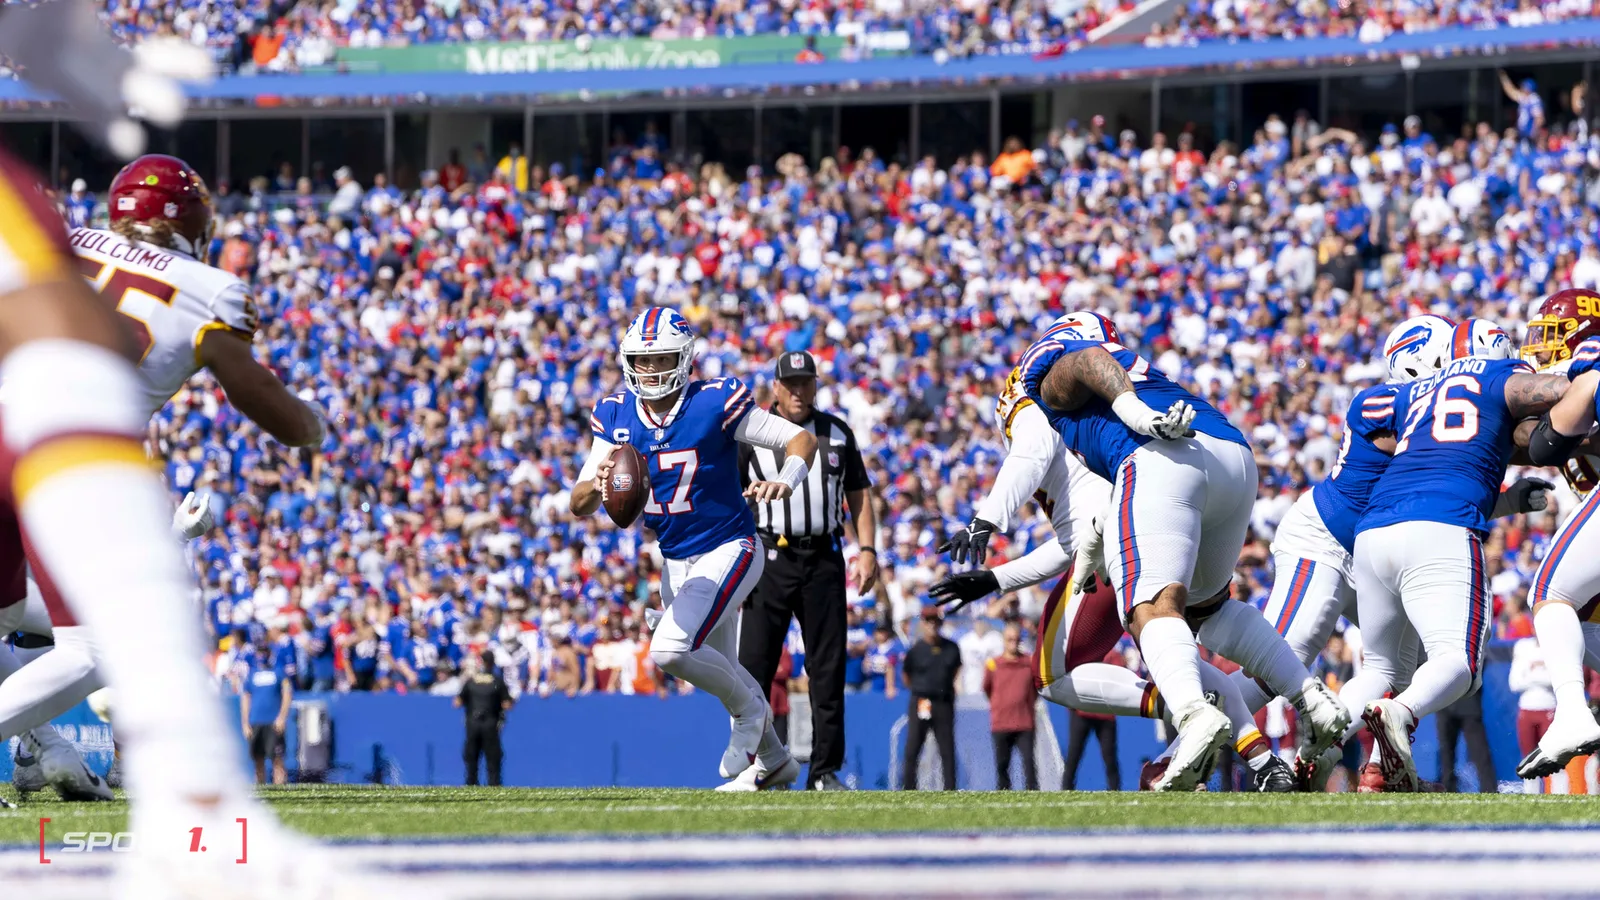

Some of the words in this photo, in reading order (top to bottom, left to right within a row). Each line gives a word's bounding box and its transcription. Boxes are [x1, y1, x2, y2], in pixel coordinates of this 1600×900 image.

[465, 46, 545, 74] M&T
[69, 229, 175, 272] HOLCOMB
[1409, 359, 1487, 404] FELICIANO
[1394, 374, 1482, 457] 76
[613, 428, 630, 442] C
[649, 442, 671, 452] BILLS
